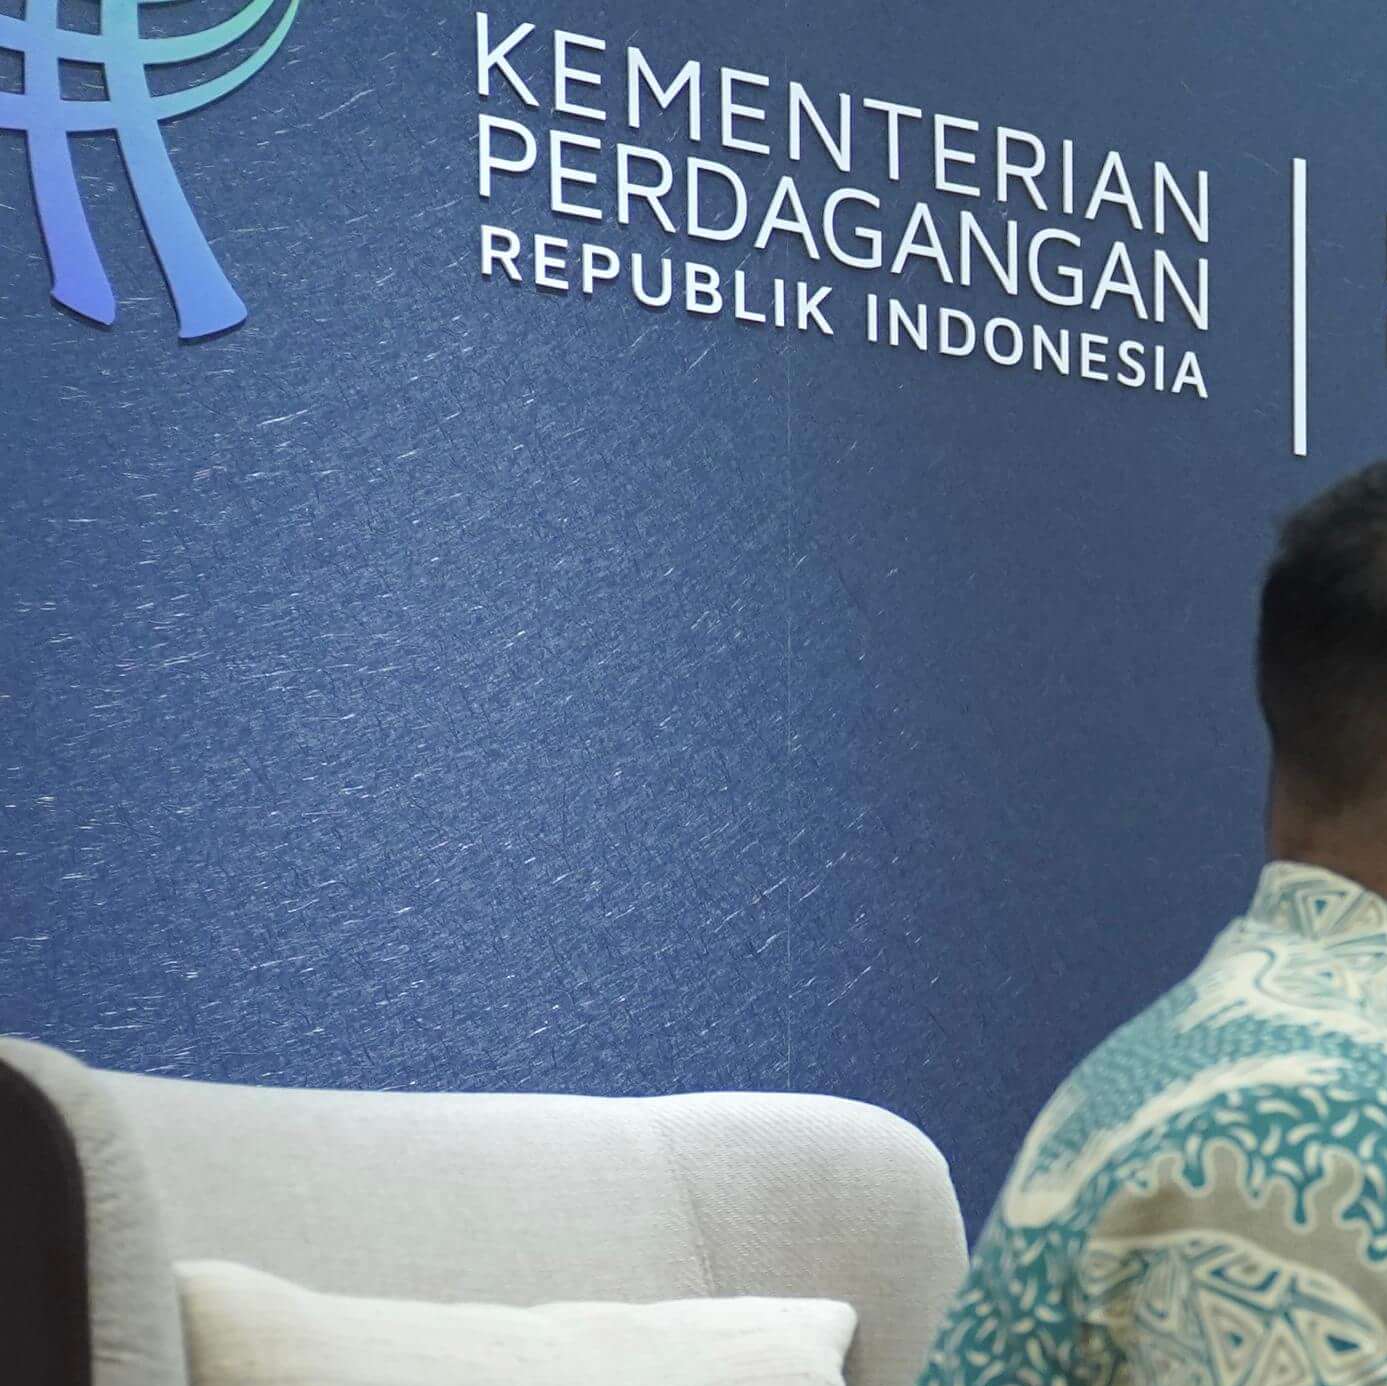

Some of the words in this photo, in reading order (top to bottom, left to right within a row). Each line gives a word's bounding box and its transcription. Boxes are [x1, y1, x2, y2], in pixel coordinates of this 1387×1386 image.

[476, 12, 1208, 242] KEMENTERIAN
[478, 113, 1208, 331] PERDAGANGAN
[480, 224, 833, 335] REPUBLIK
[867, 293, 1208, 398] INDONESIA
